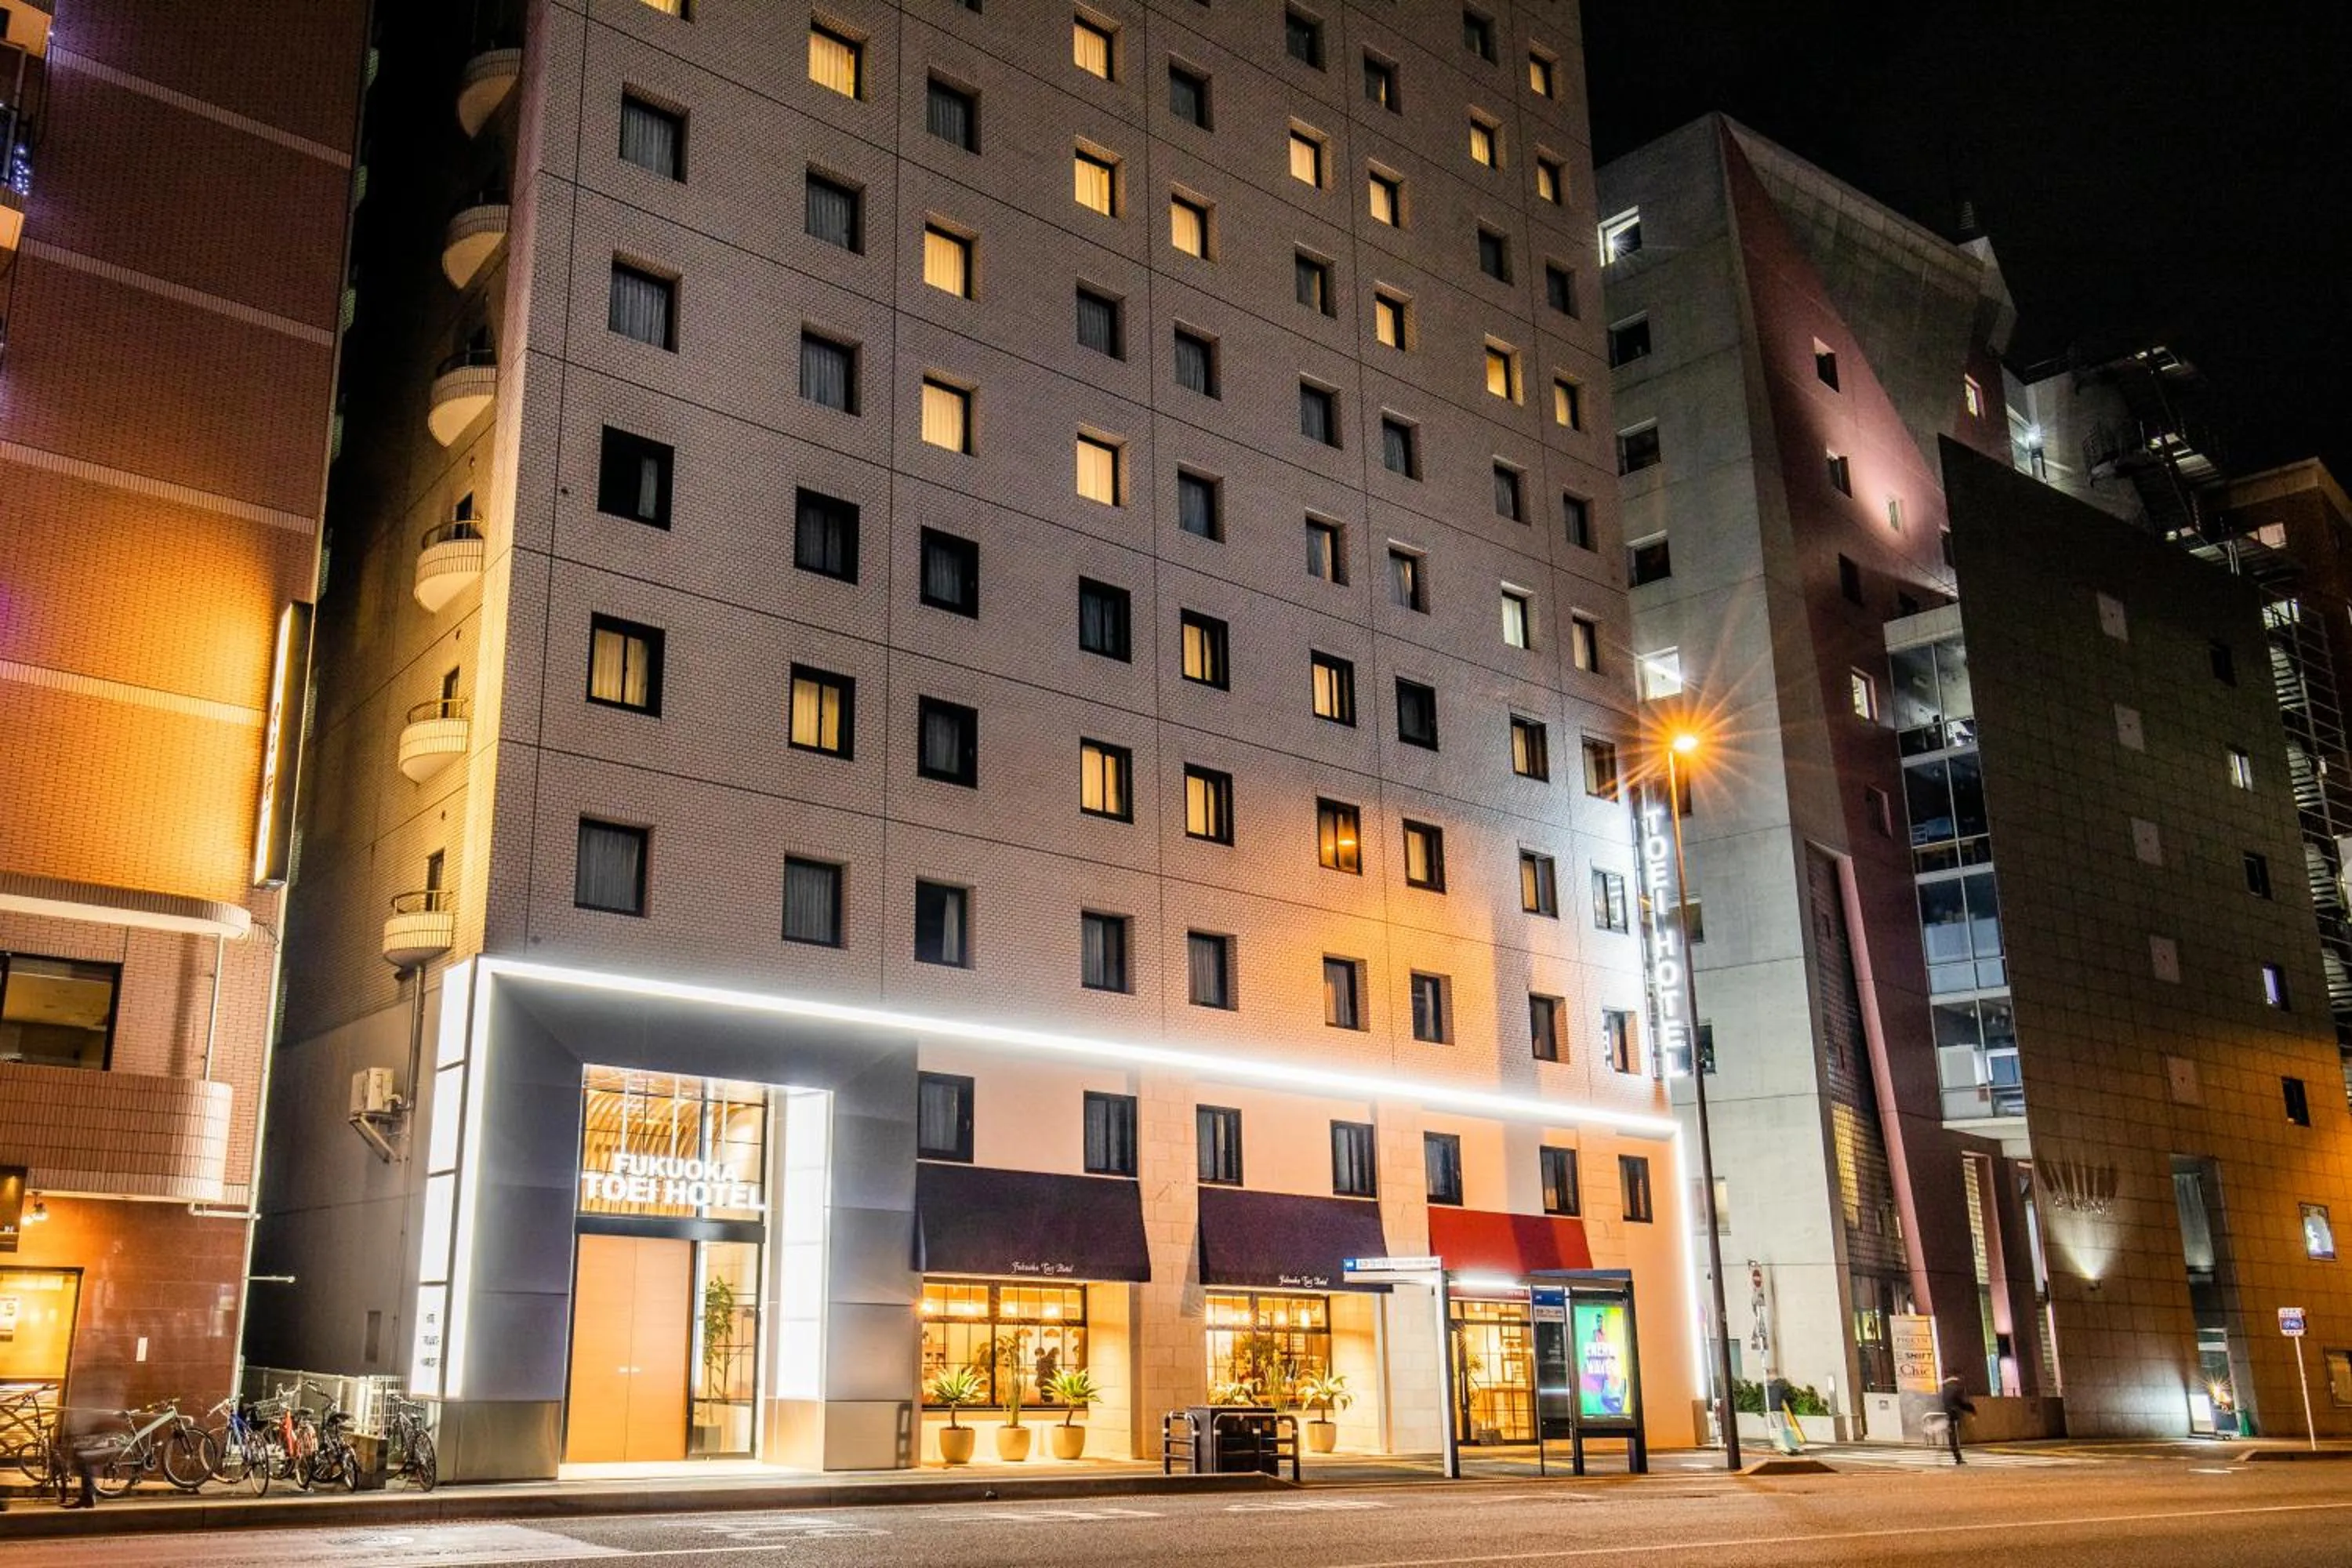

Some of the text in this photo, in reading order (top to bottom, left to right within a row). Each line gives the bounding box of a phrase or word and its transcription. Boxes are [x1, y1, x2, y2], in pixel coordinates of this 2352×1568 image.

[1645, 805, 1689, 1078] TOEI HOTEL
[614, 1152, 739, 1182] FUKUOKA
[581, 1171, 766, 1210] TOEI HOTEL
